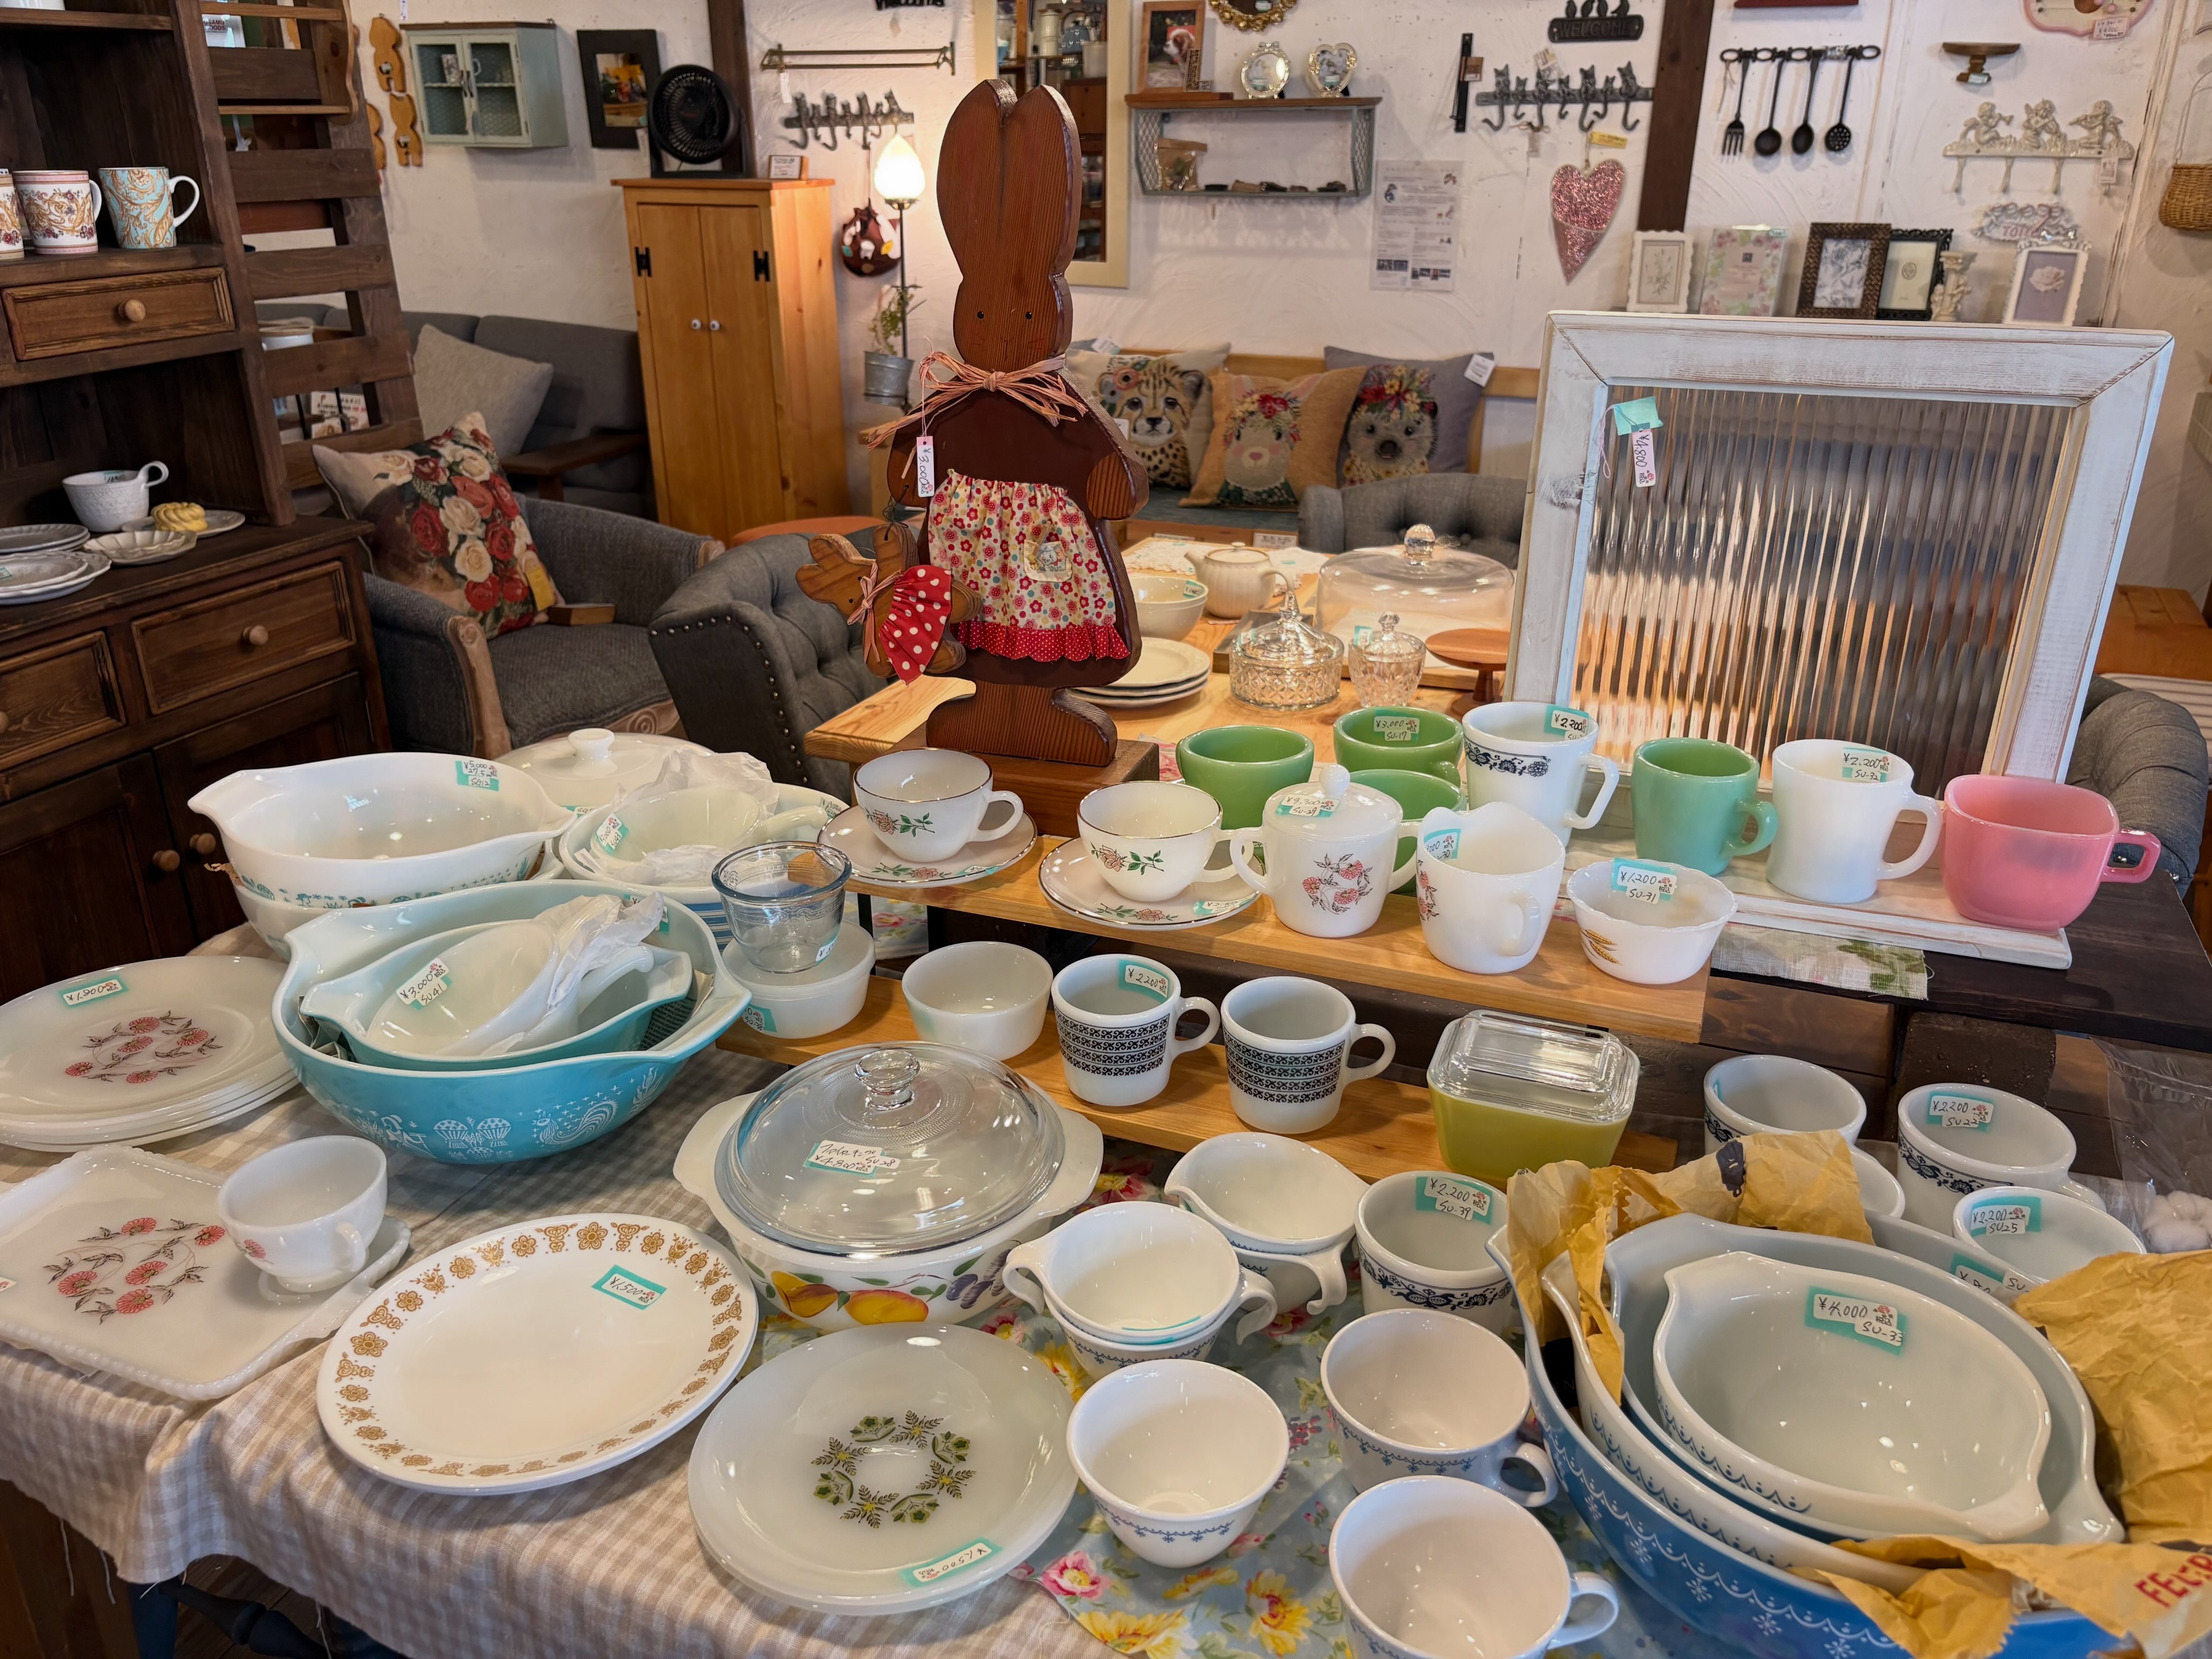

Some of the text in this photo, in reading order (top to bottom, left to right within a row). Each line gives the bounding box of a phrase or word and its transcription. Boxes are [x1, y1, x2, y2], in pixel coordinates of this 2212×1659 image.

[1559, 19, 1631, 37] WELCOME
[1386, 731, 1407, 741] SU-17
[1854, 770, 1879, 781] SU-32
[1293, 807, 1317, 816] SU-29
[1629, 889, 1657, 903] SU-31
[1439, 1200, 1472, 1219] SU-39
[1989, 1223, 2018, 1234] SU25
[2005, 1278, 2029, 1293] SU-
